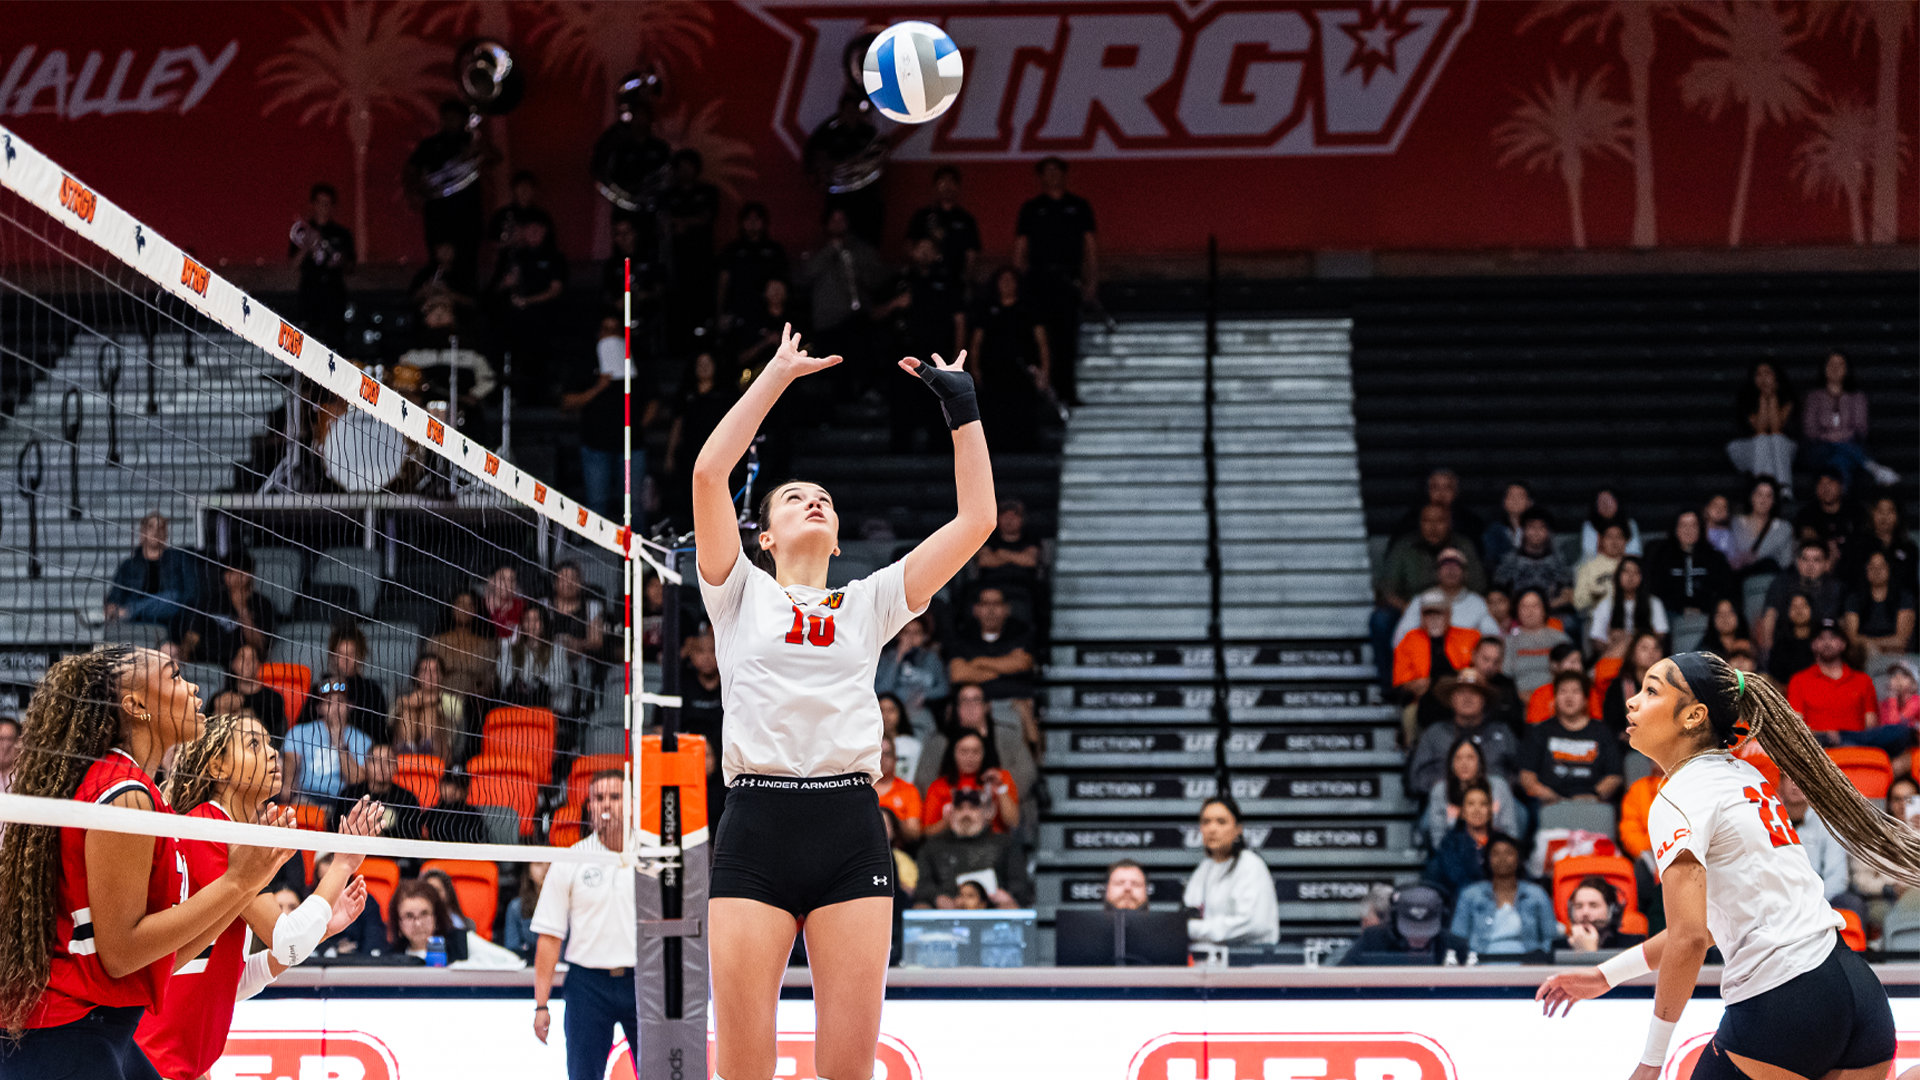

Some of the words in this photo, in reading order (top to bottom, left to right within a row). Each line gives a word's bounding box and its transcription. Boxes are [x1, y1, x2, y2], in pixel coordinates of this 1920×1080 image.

[59, 172, 97, 224] UTRGV
[181, 253, 210, 298] UTRGV
[785, 605, 835, 647] 10
[1081, 692, 1143, 705] SECTION
[1283, 691, 1347, 705] SECTION
[1079, 736, 1142, 749] SECTION
[1286, 735, 1350, 749] SECTION
[757, 780, 798, 790] UNDER
[801, 779, 852, 790] ARMOUR
[1076, 781, 1142, 797] SECTION
[1290, 780, 1357, 797] SECTION
[1743, 781, 1801, 848] 22
[1073, 831, 1141, 847] SECTION
[1143, 831, 1155, 847] F
[1293, 830, 1362, 847] SECTION
[1299, 882, 1369, 899] SECTION
